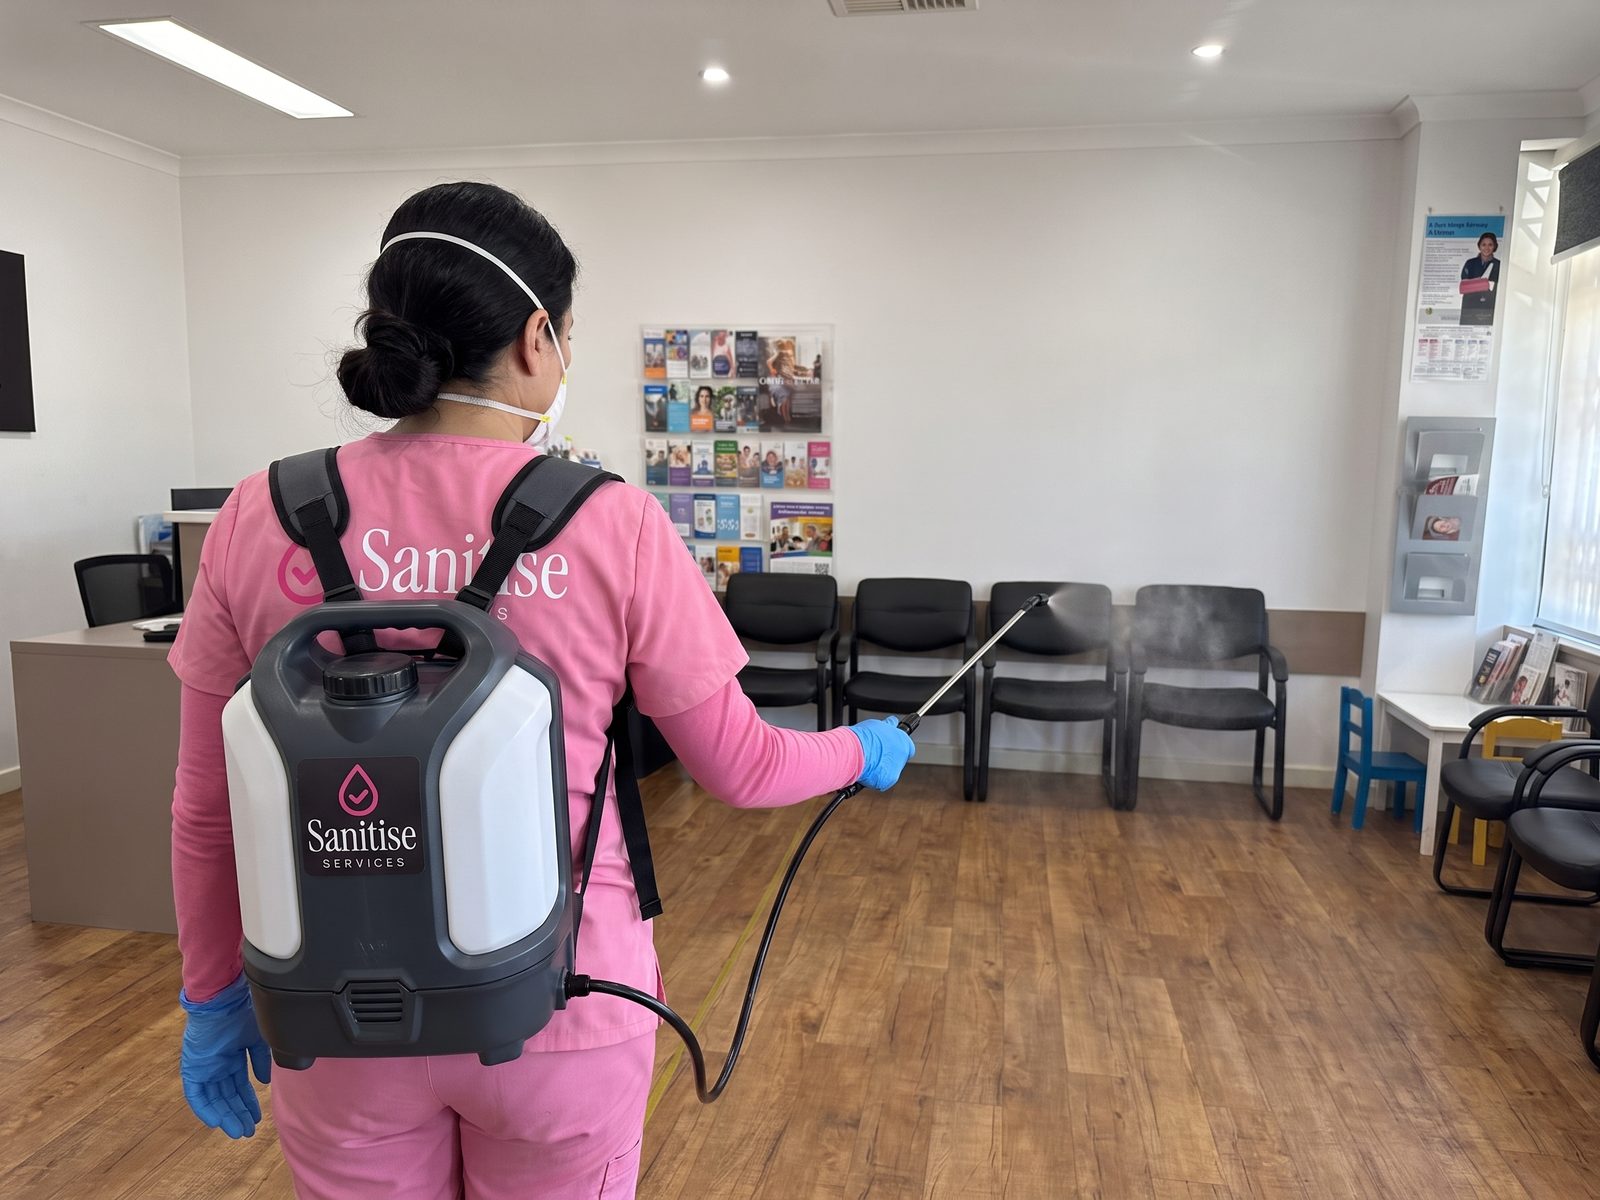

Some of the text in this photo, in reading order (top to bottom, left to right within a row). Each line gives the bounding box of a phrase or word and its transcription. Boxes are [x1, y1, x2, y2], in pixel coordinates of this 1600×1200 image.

[358, 528, 569, 600] Sanise
[307, 818, 417, 853] Sanitise
[322, 857, 405, 869] SERVICES
